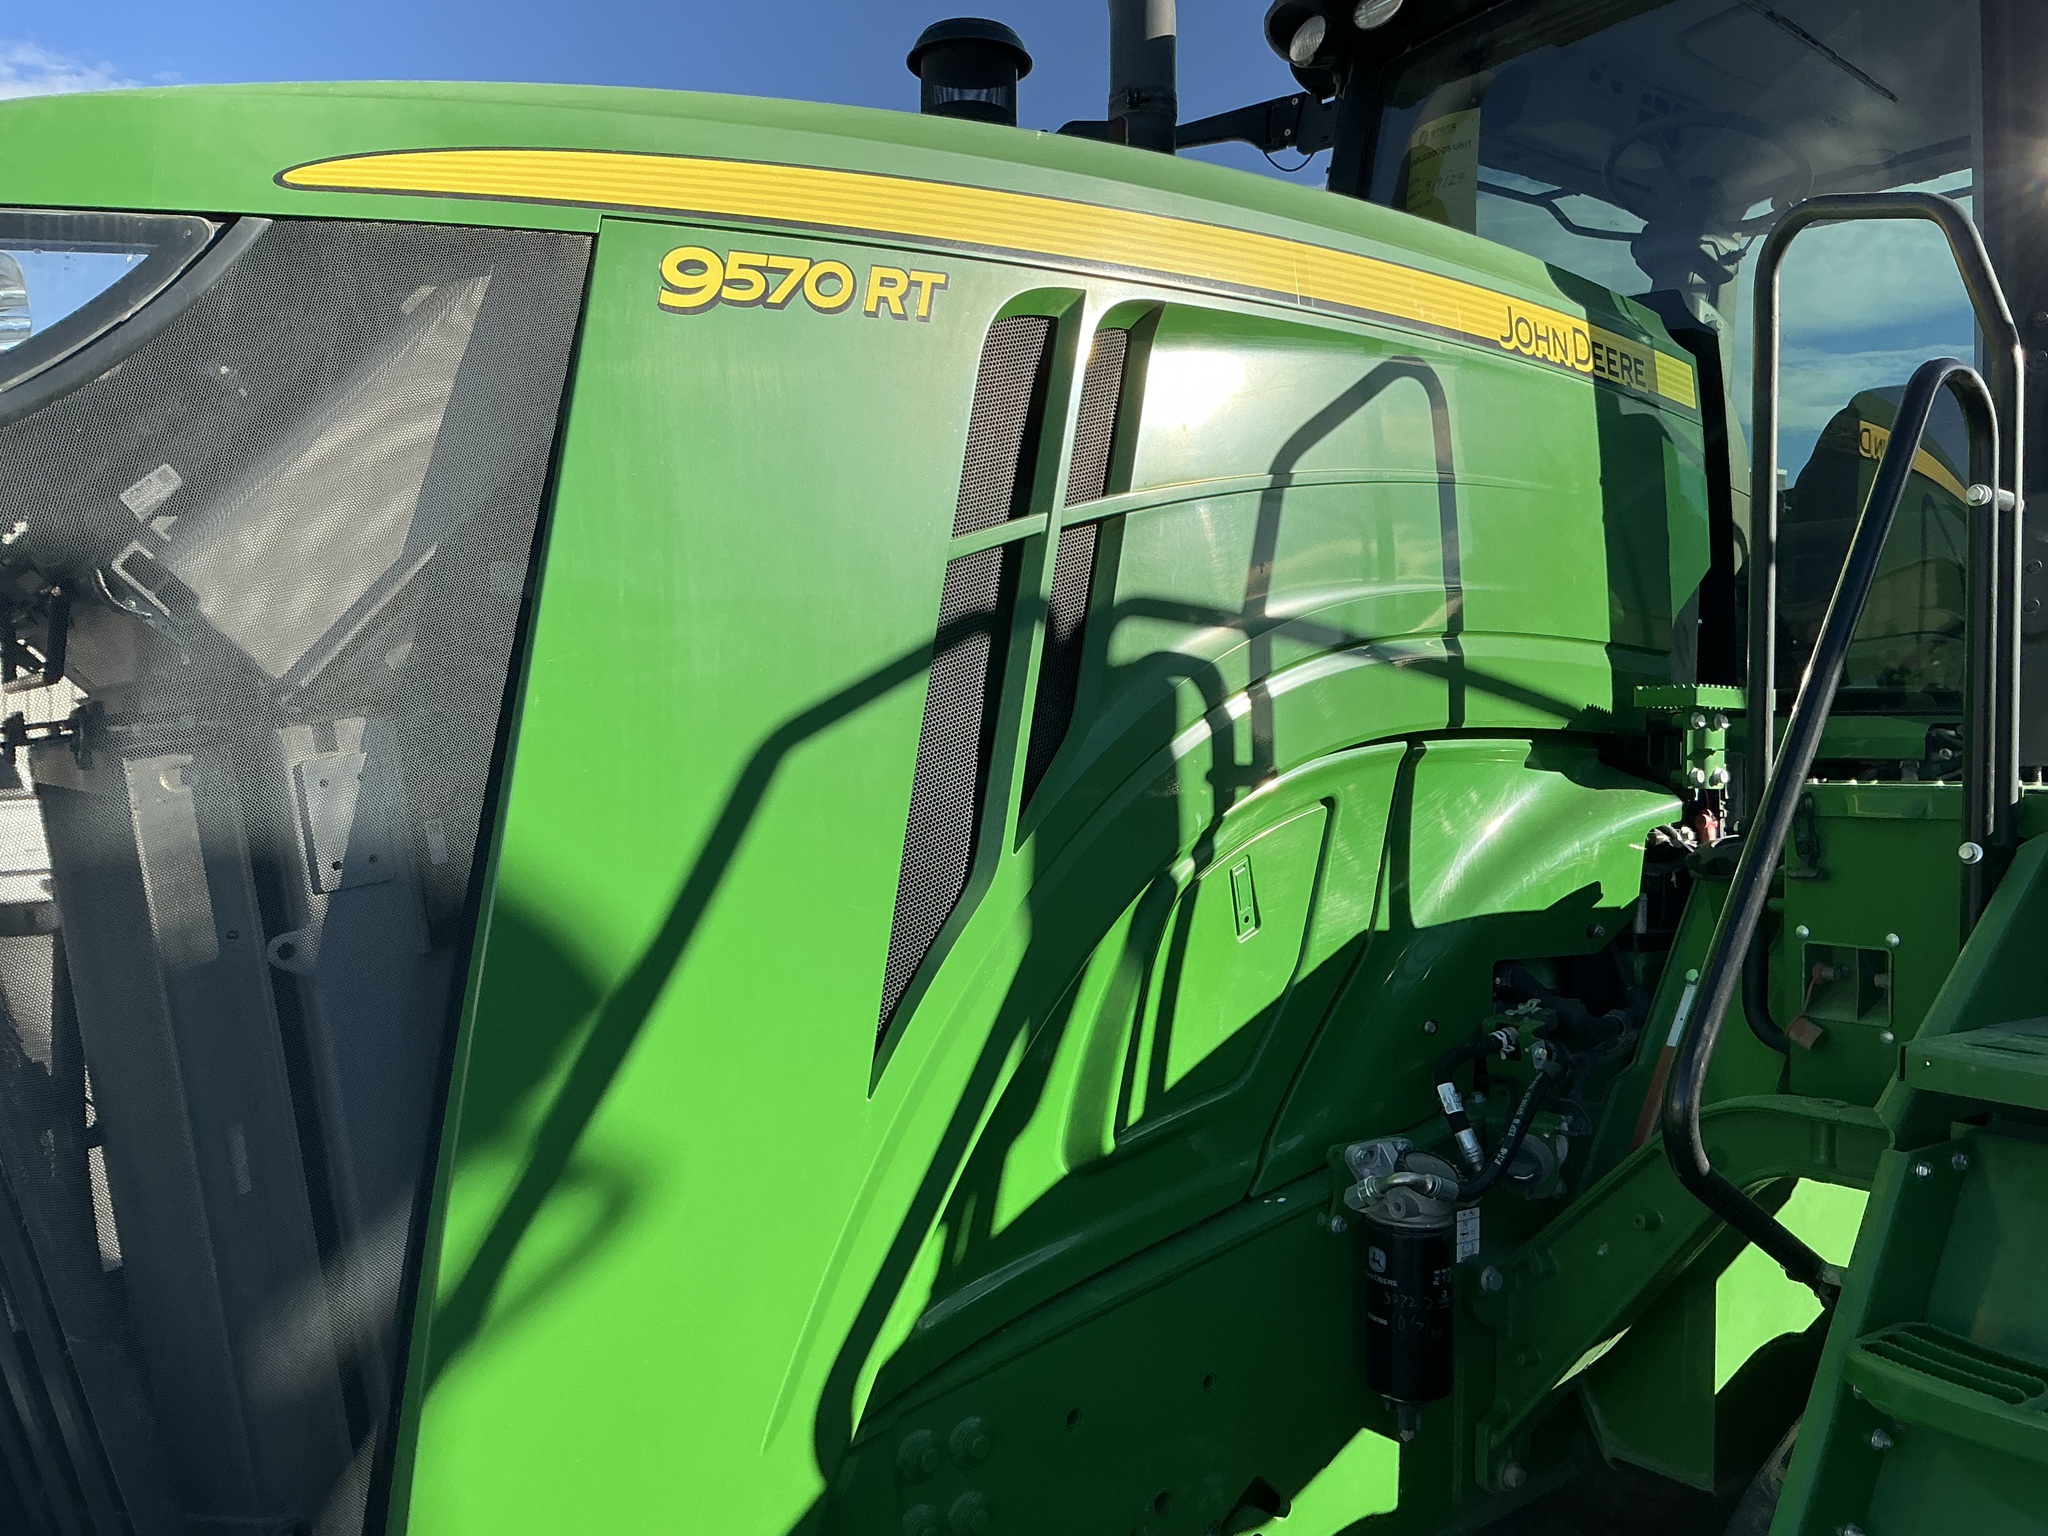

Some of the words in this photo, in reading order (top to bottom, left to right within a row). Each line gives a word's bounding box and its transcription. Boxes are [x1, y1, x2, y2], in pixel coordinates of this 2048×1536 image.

[658, 245, 857, 316] 9570
[863, 264, 950, 323] RT
[1499, 305, 1570, 365] JOHN
[1571, 326, 1649, 392] DEERE
